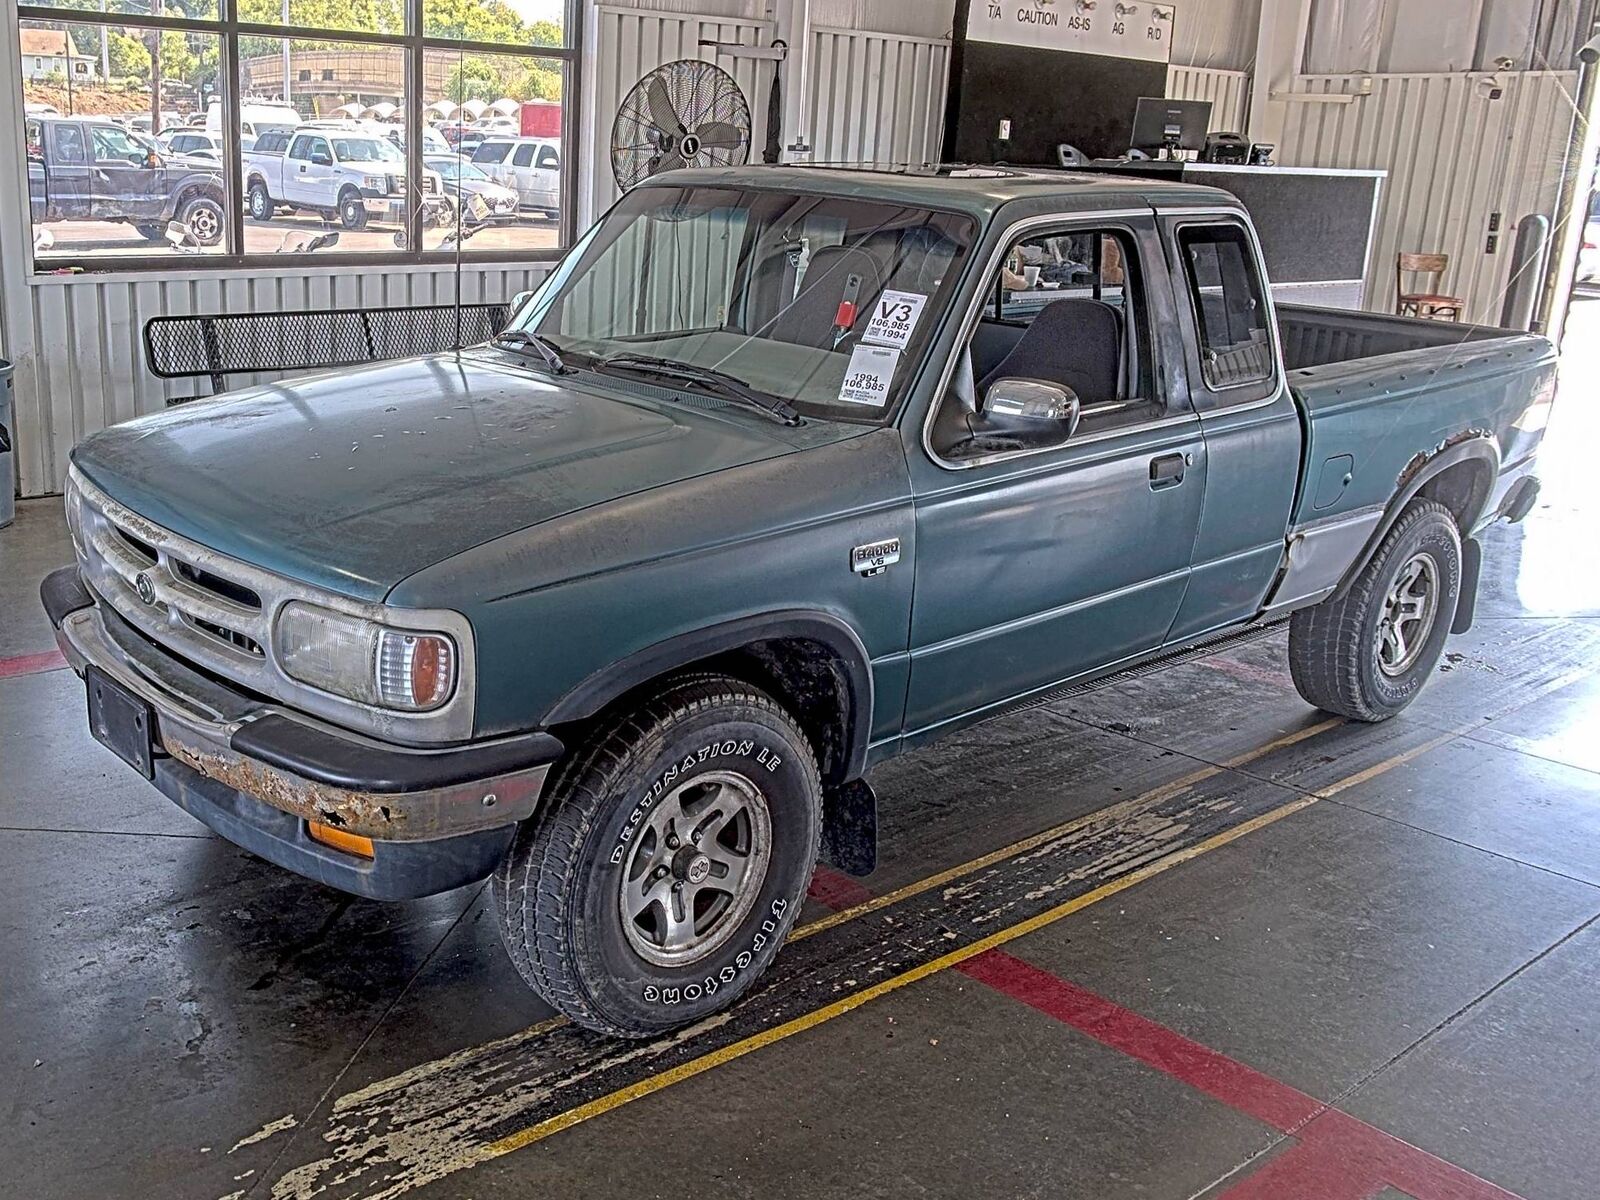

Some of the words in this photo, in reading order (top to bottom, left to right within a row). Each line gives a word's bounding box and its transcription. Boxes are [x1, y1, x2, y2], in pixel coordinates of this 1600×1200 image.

[988, 5, 1001, 19] T/A
[1017, 9, 1058, 27] CAUTION
[1068, 16, 1091, 31] AS-IS
[1112, 22, 1124, 35] AG
[881, 301, 913, 322] V3
[871, 318, 911, 332] 106,985
[882, 329, 906, 340] 1994
[844, 379, 885, 392] 106,985
[854, 373, 879, 384] 1994
[856, 541, 899, 561] B4000
[870, 557, 884, 566] V6
[610, 740, 755, 865] DESTINATION
[757, 748, 782, 773] LE
